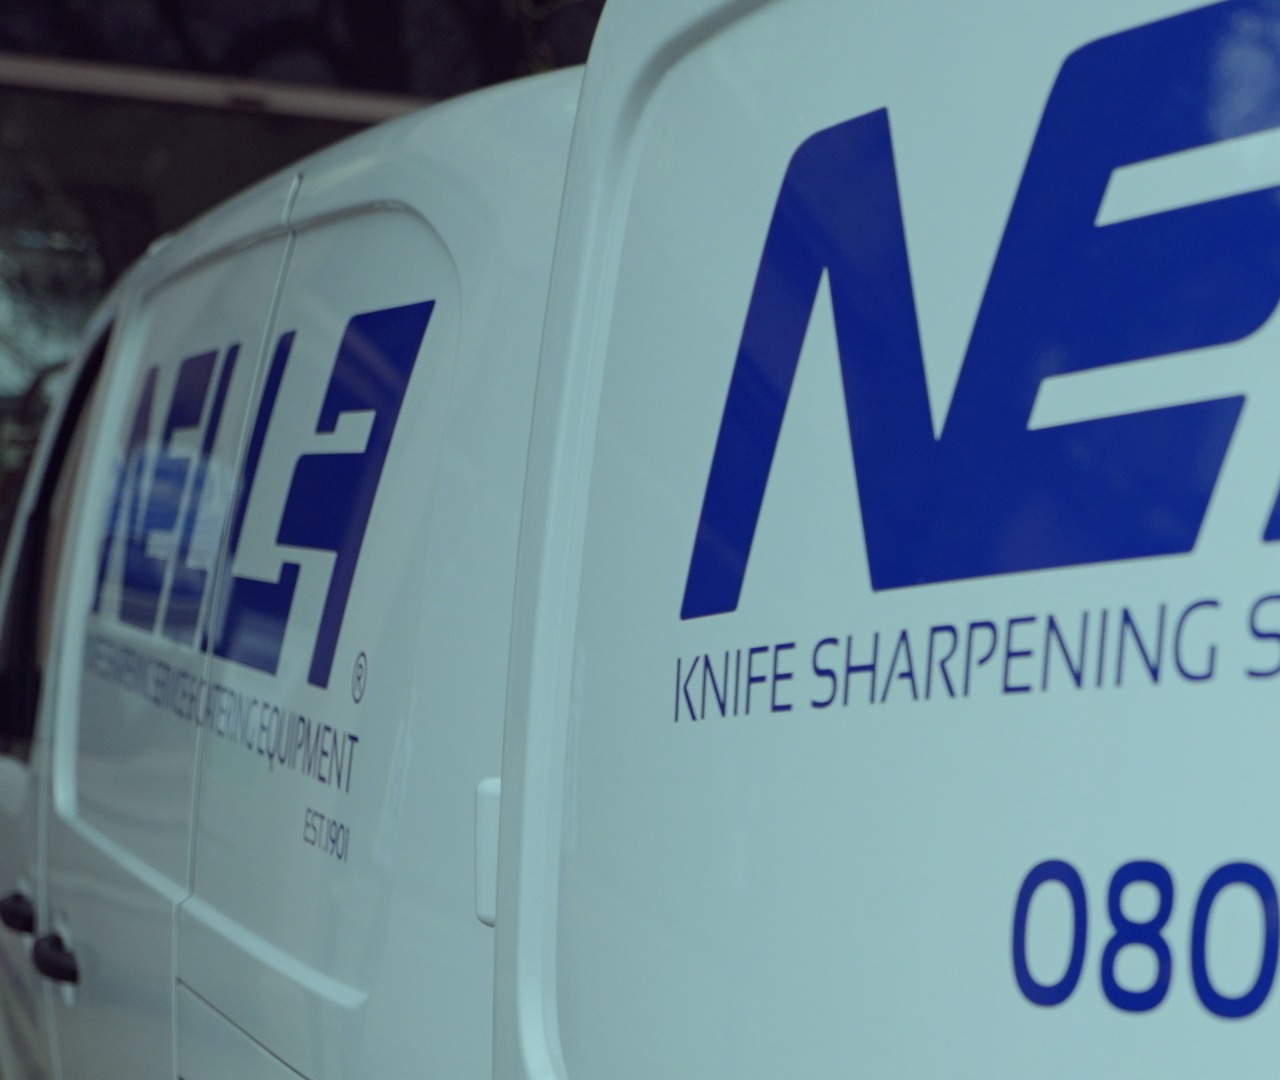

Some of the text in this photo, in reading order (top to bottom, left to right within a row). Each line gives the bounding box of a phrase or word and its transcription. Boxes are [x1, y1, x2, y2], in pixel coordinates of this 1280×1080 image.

[674, 642, 796, 723] KNIFE
[811, 599, 1222, 709] SHARPENING
[256, 700, 360, 795] EQUIPMENT
